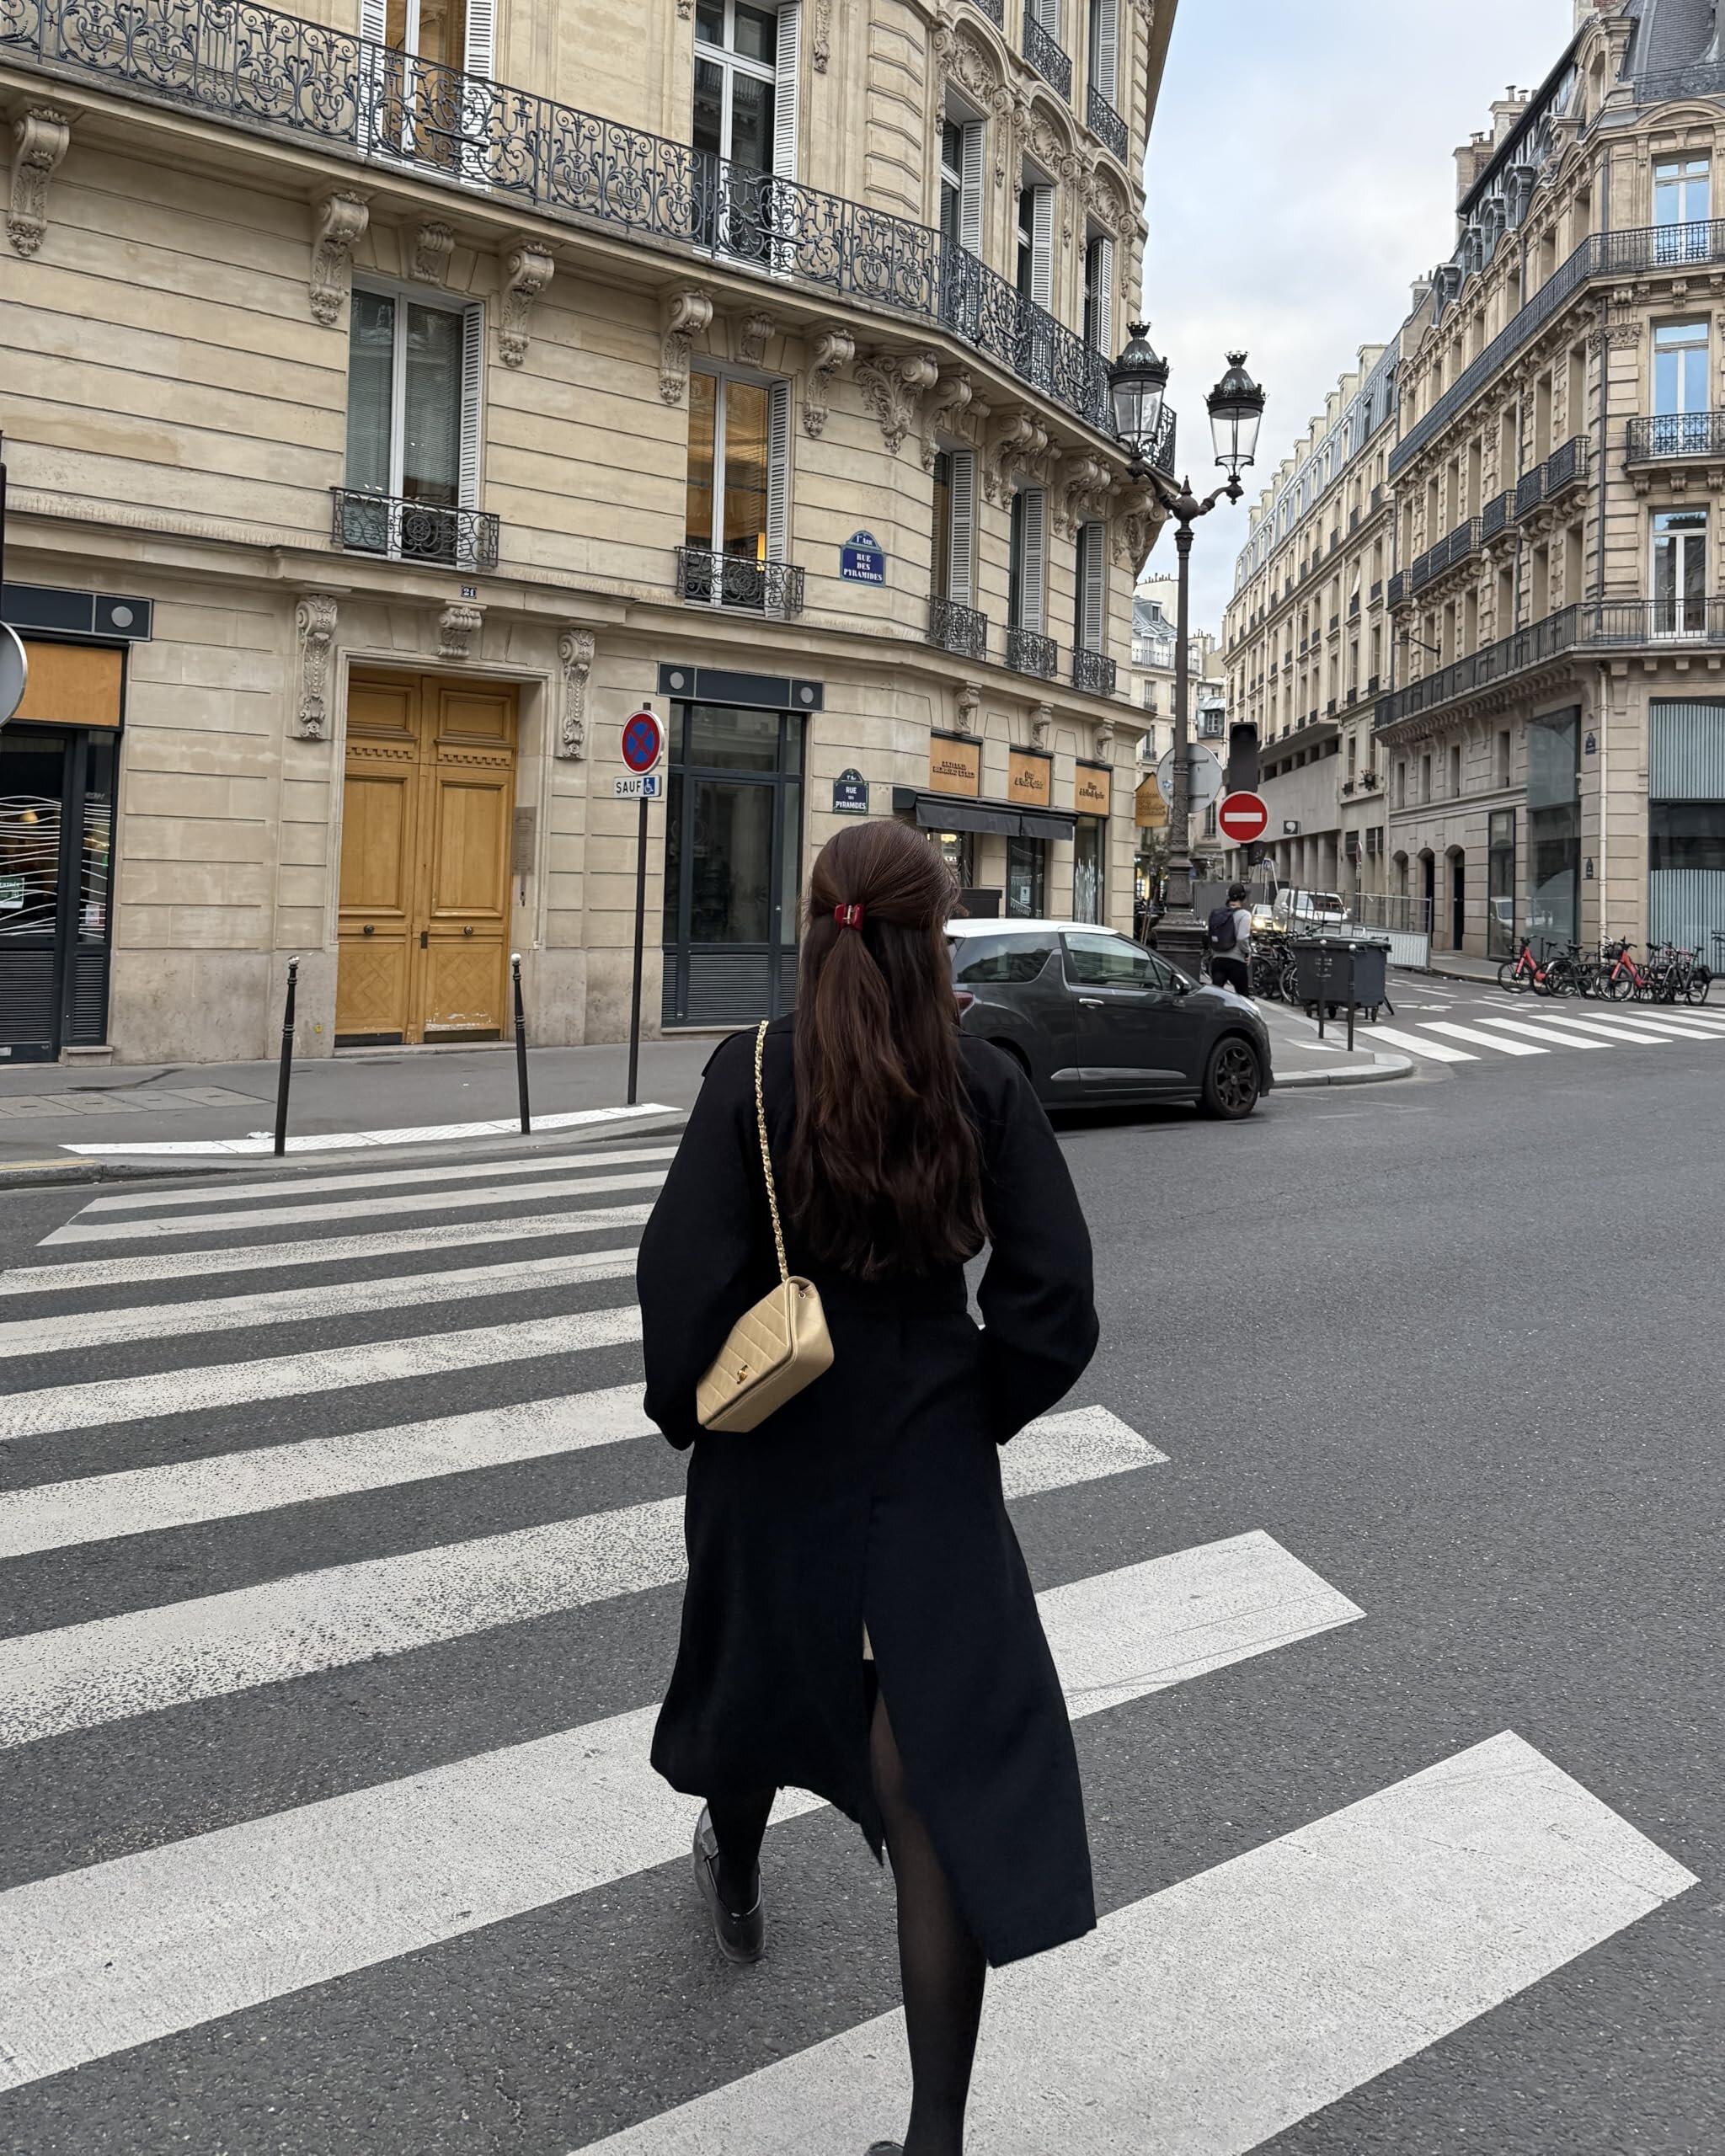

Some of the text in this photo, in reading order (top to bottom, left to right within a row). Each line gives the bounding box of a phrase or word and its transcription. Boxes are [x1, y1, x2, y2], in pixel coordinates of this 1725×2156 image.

[857, 553, 871, 563] RUE
[843, 568, 883, 580] PYRAMIDES
[463, 588, 474, 596] 21
[616, 781, 641, 793] SAUF
